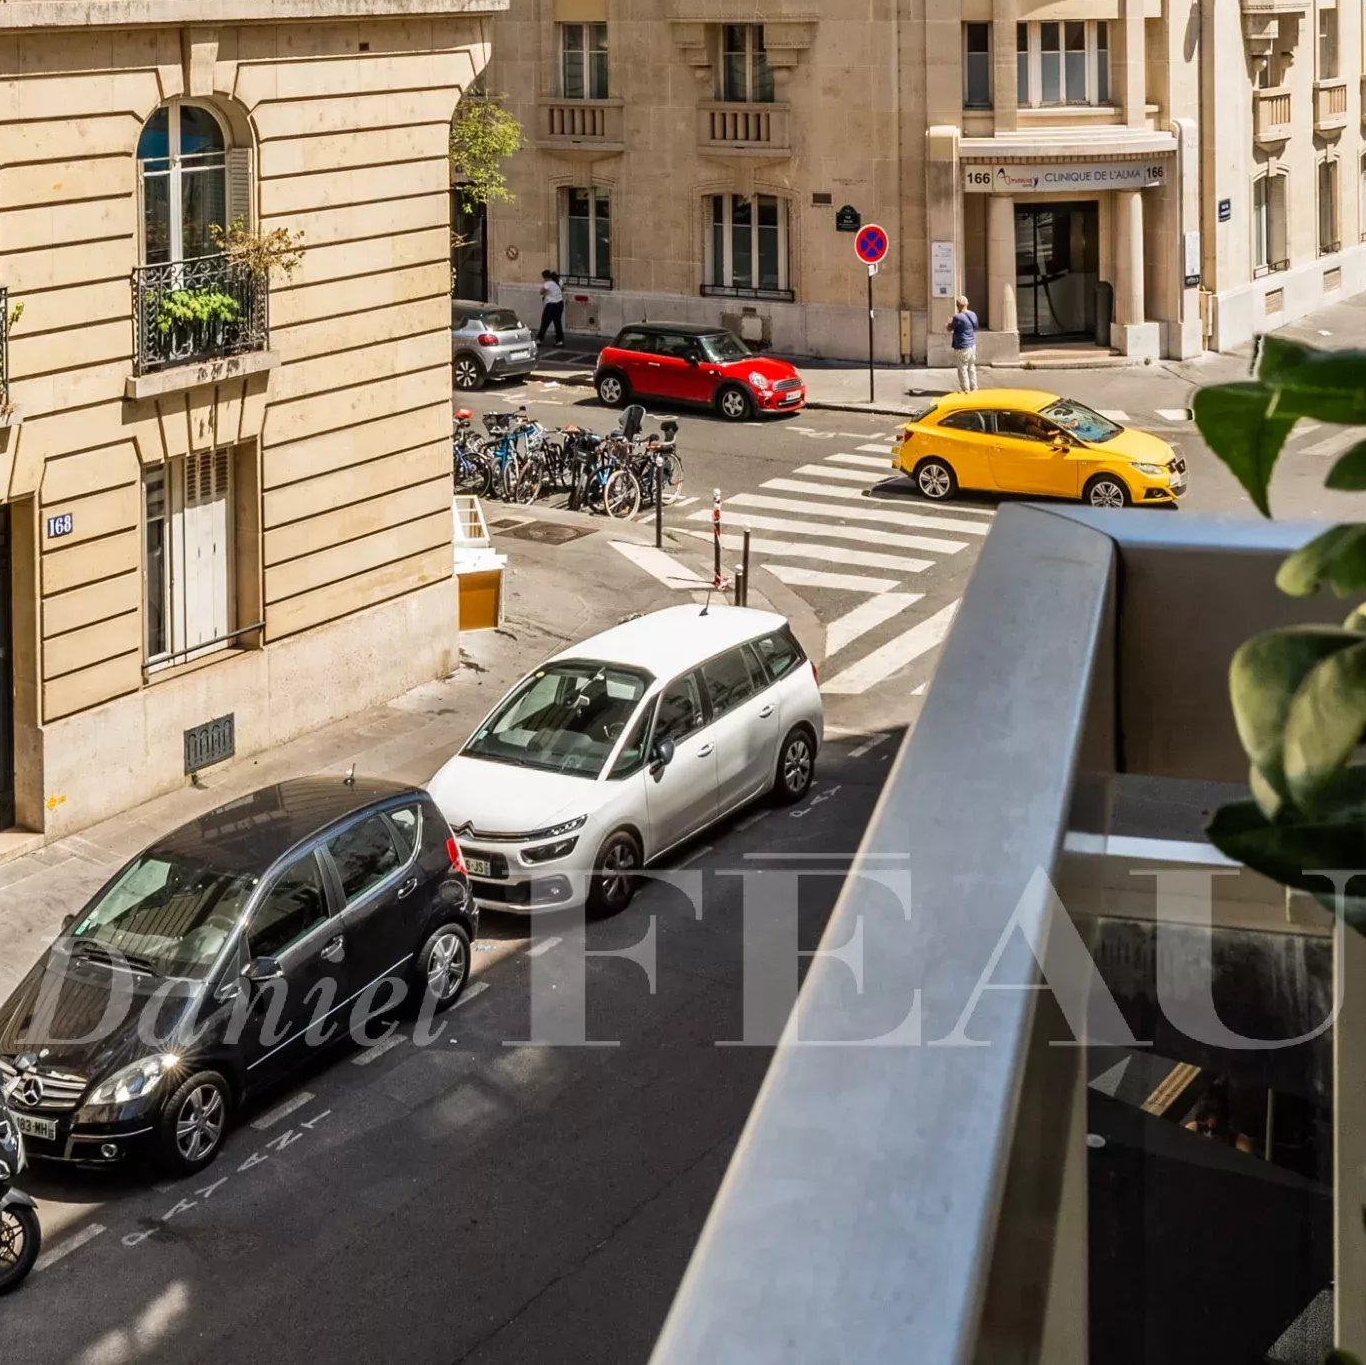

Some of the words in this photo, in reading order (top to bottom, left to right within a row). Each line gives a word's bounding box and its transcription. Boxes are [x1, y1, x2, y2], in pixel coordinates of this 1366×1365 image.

[967, 173, 990, 184] 166
[1044, 171, 1092, 183] CLINIQUE
[1094, 170, 1108, 181] DE
[1109, 169, 1141, 180] L'ALMA
[1146, 166, 1163, 178] 166
[49, 515, 72, 537] 168
